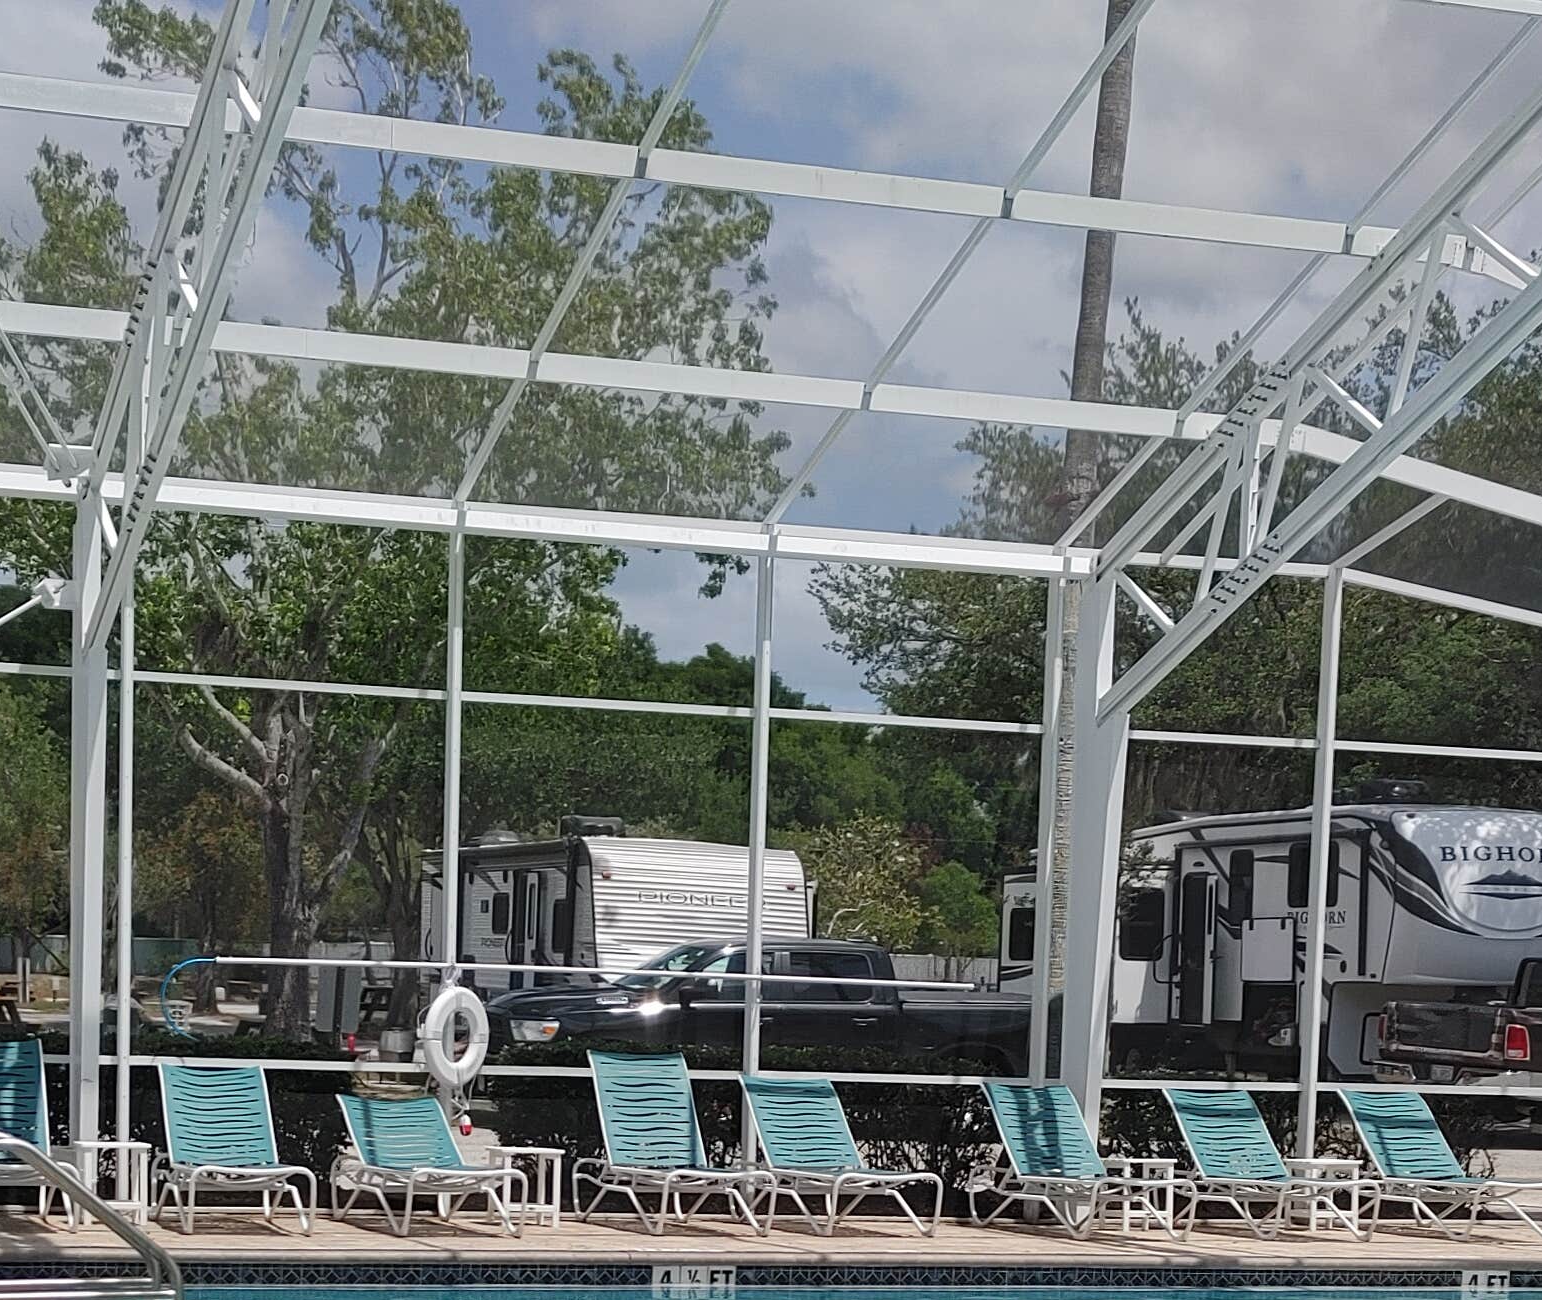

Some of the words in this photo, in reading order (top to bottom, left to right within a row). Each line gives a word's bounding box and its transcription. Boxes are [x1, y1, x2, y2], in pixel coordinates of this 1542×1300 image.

[638, 890, 766, 909] PIONEE
[660, 1270, 673, 1284] 4
[710, 1270, 734, 1286] FT
[1487, 1274, 1508, 1287] FT
